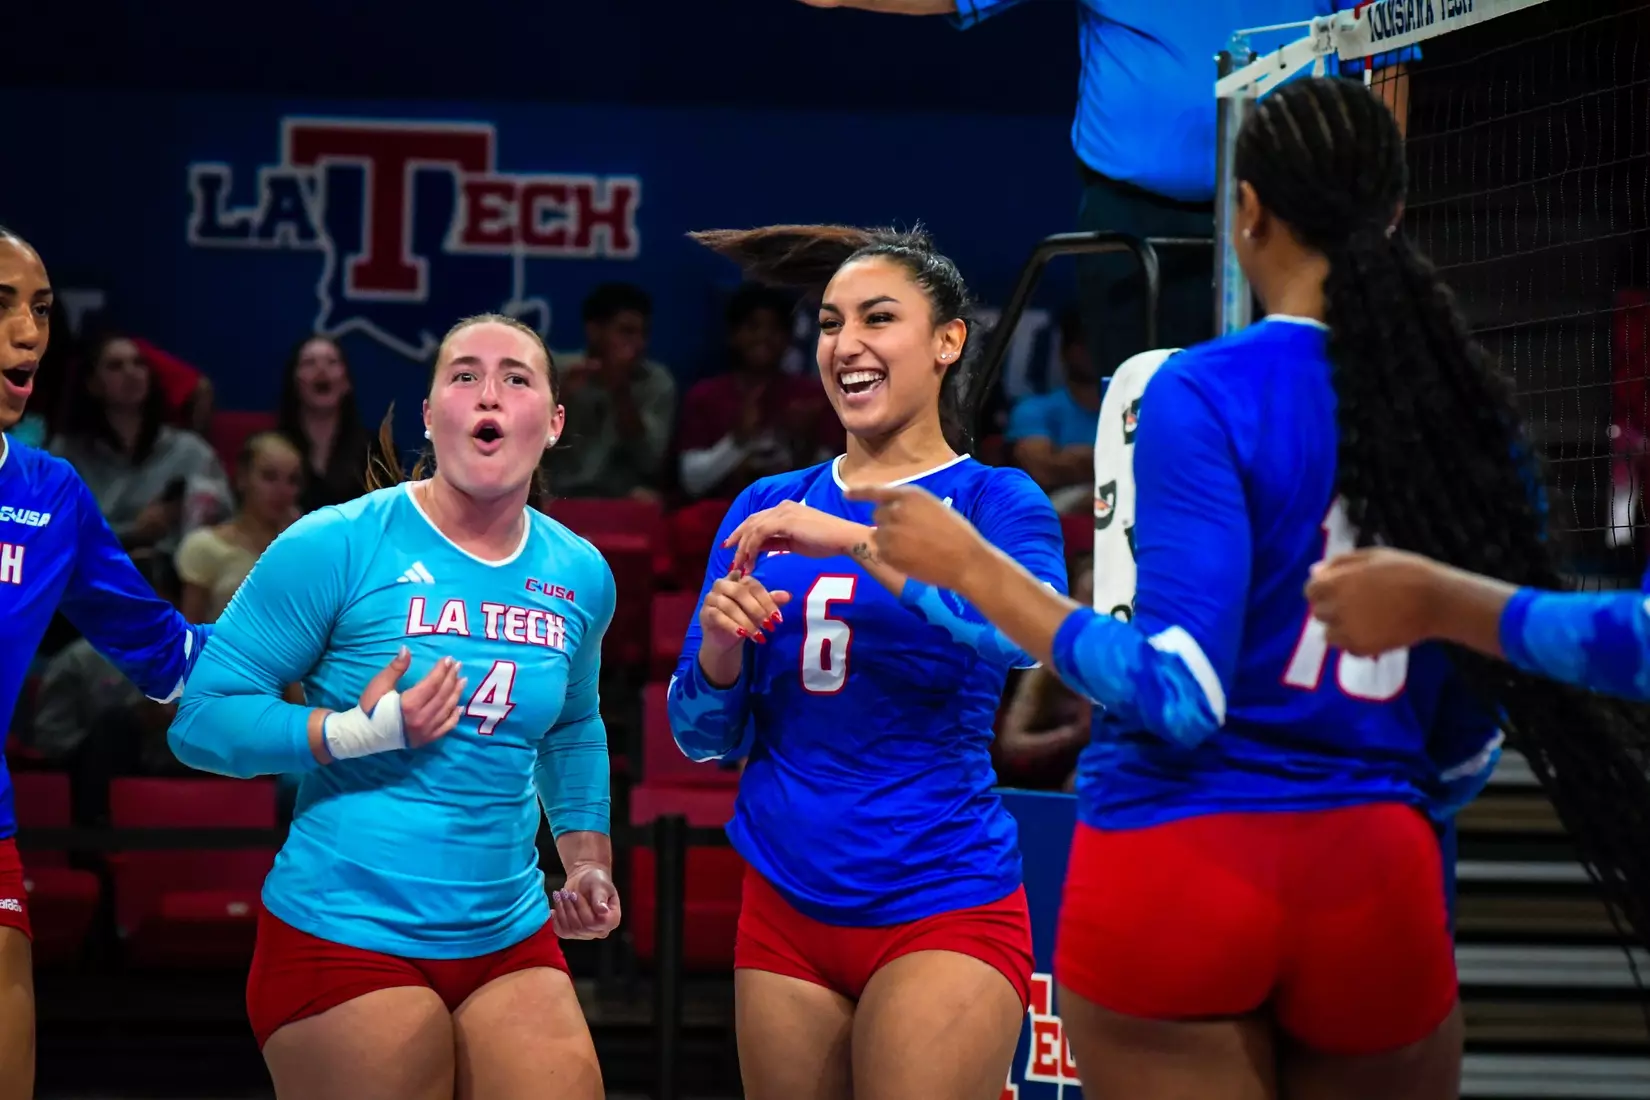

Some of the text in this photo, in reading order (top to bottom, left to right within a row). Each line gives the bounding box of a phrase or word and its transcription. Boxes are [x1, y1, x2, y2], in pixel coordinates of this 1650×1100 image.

[406, 597, 566, 650] LA TECH
[802, 573, 858, 695] 6
[465, 659, 517, 736] 4
